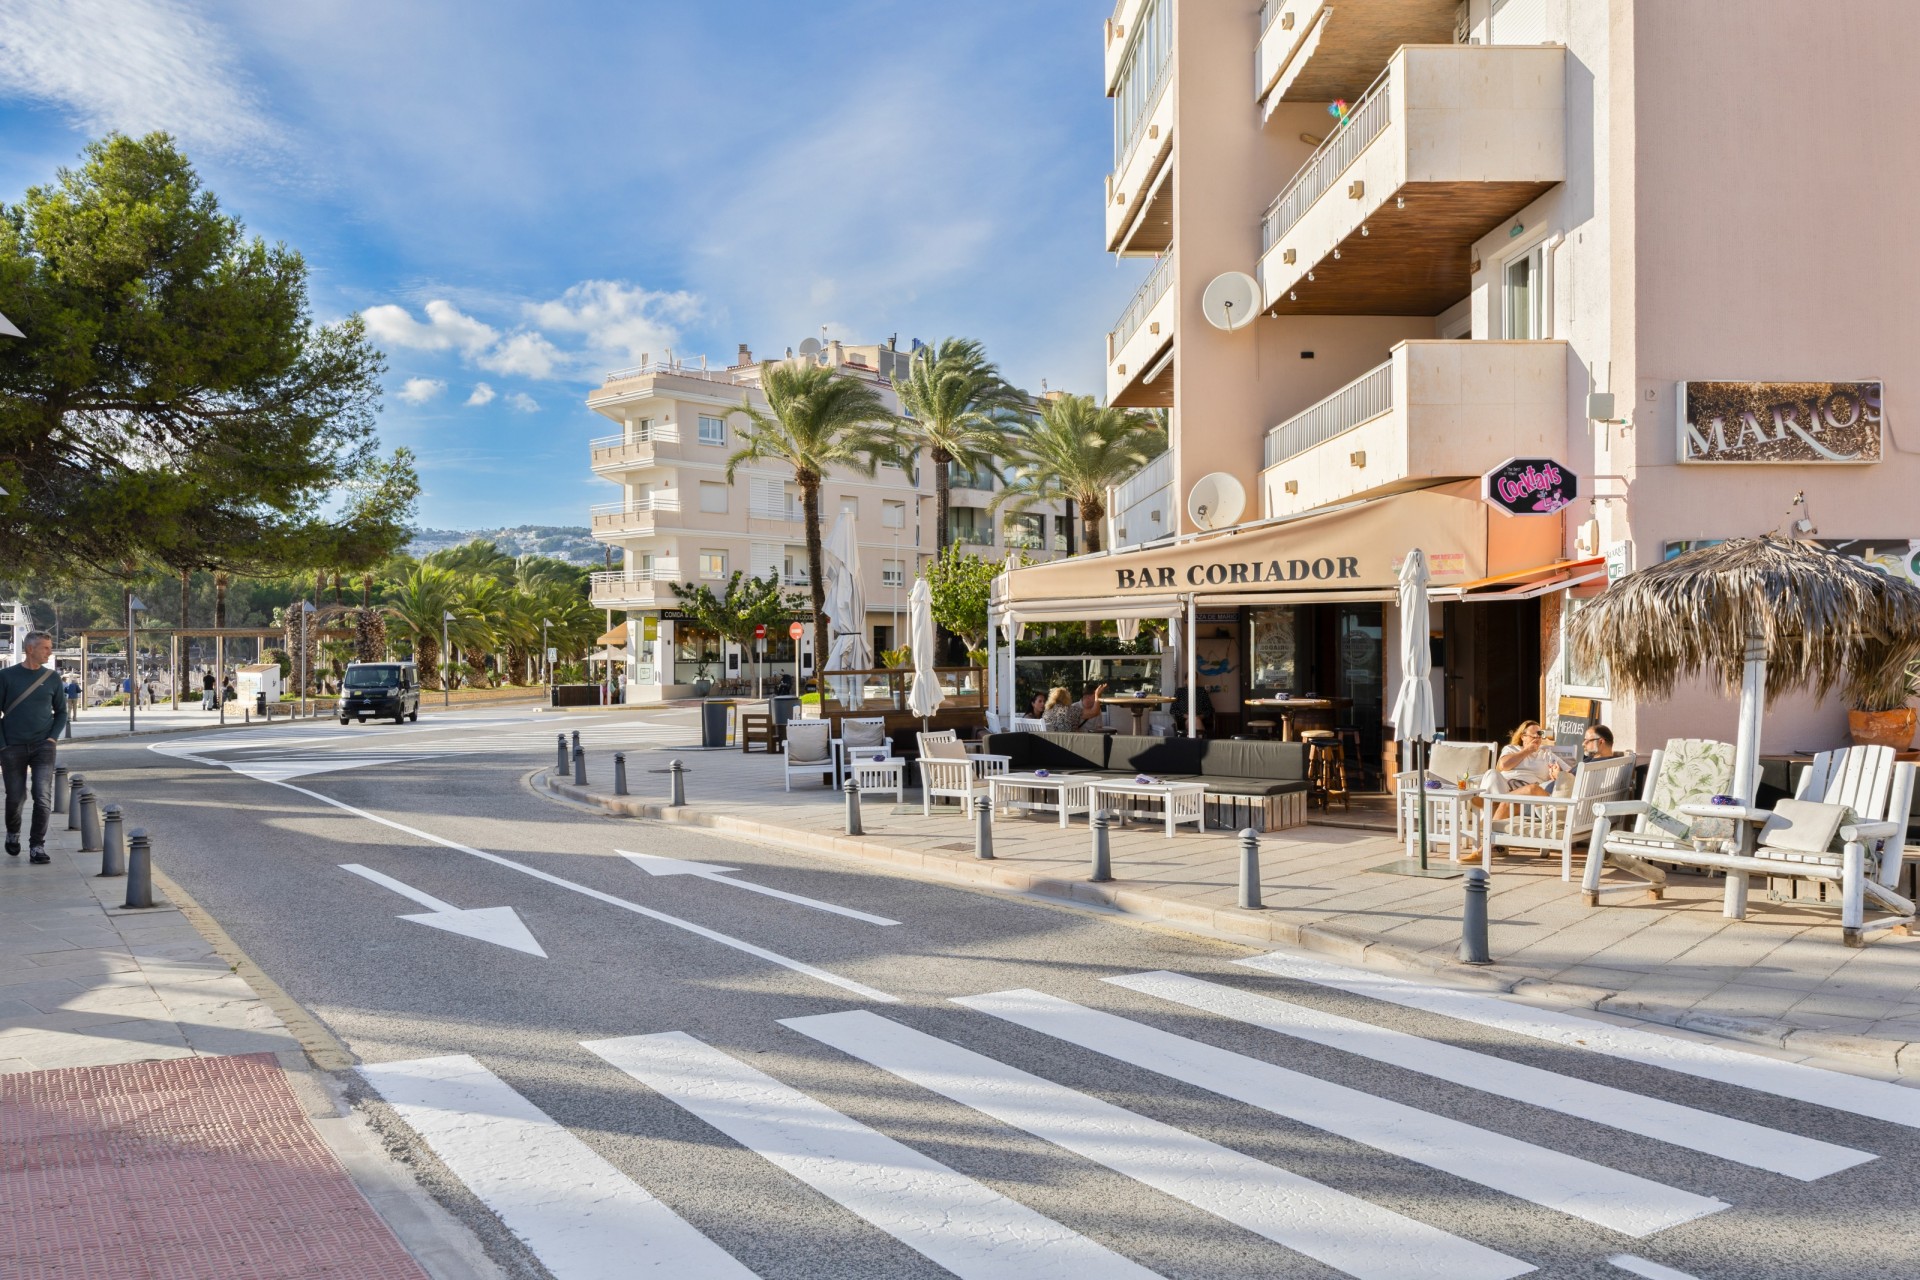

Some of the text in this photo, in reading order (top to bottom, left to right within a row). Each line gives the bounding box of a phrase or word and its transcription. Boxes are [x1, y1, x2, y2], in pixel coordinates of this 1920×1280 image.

[1497, 463, 1562, 503] Cocktails
[1115, 556, 1360, 589] BAR CORIADOR
